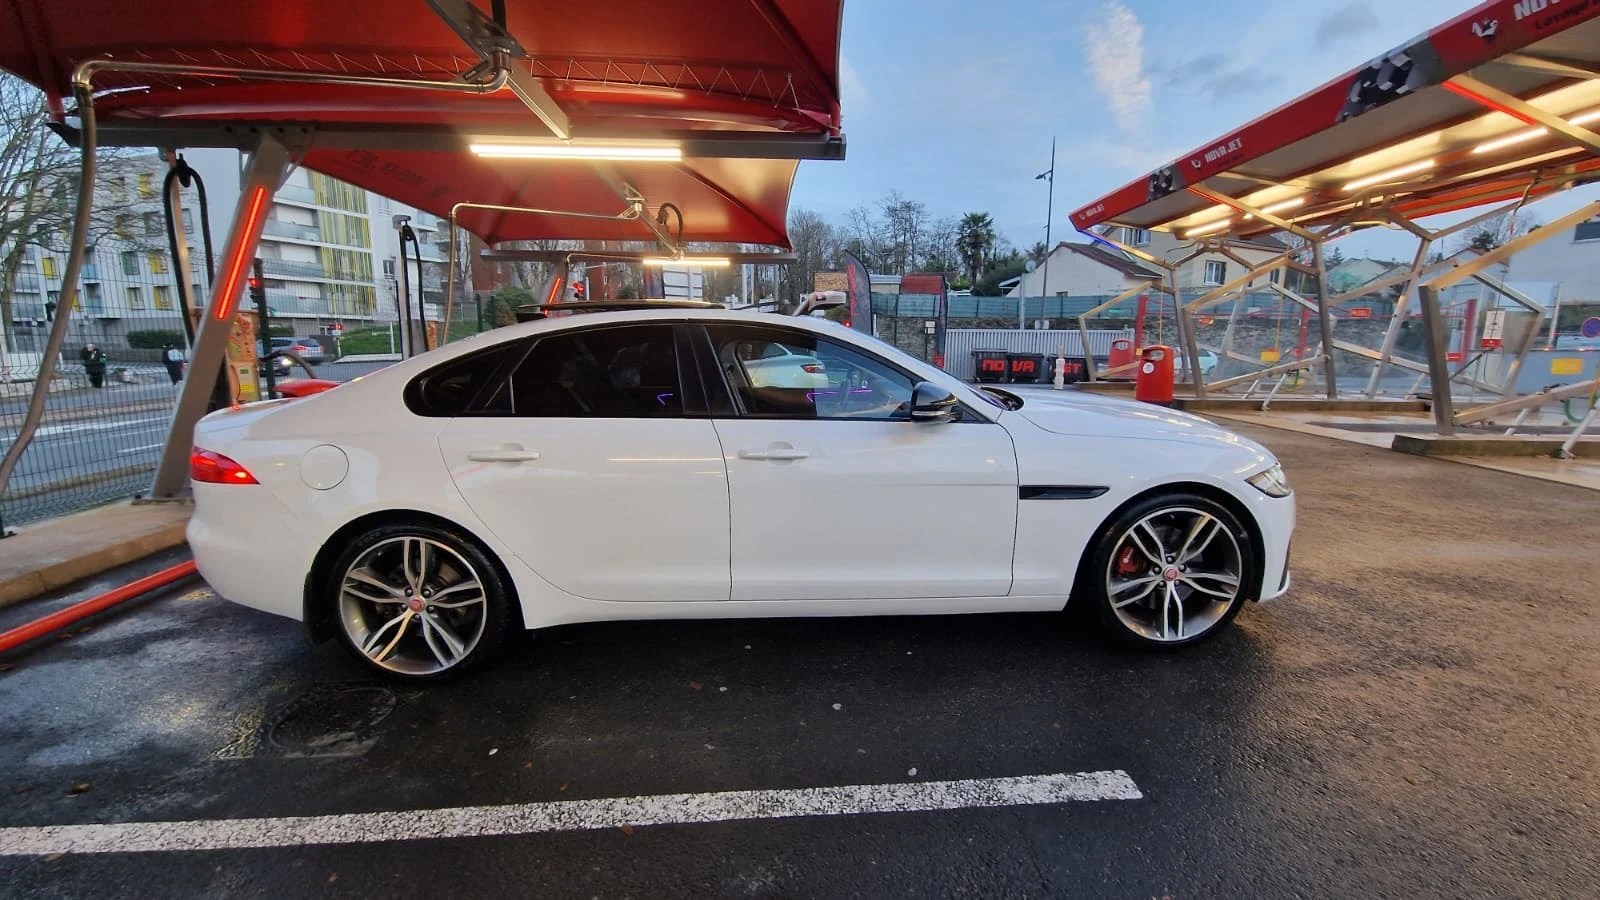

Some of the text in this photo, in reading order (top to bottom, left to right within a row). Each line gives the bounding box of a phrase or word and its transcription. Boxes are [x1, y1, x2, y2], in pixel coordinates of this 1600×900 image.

[1204, 146, 1227, 163] NOVA
[1227, 137, 1242, 153] JET
[1012, 360, 1035, 373] VA
[1053, 362, 1082, 374] ET
